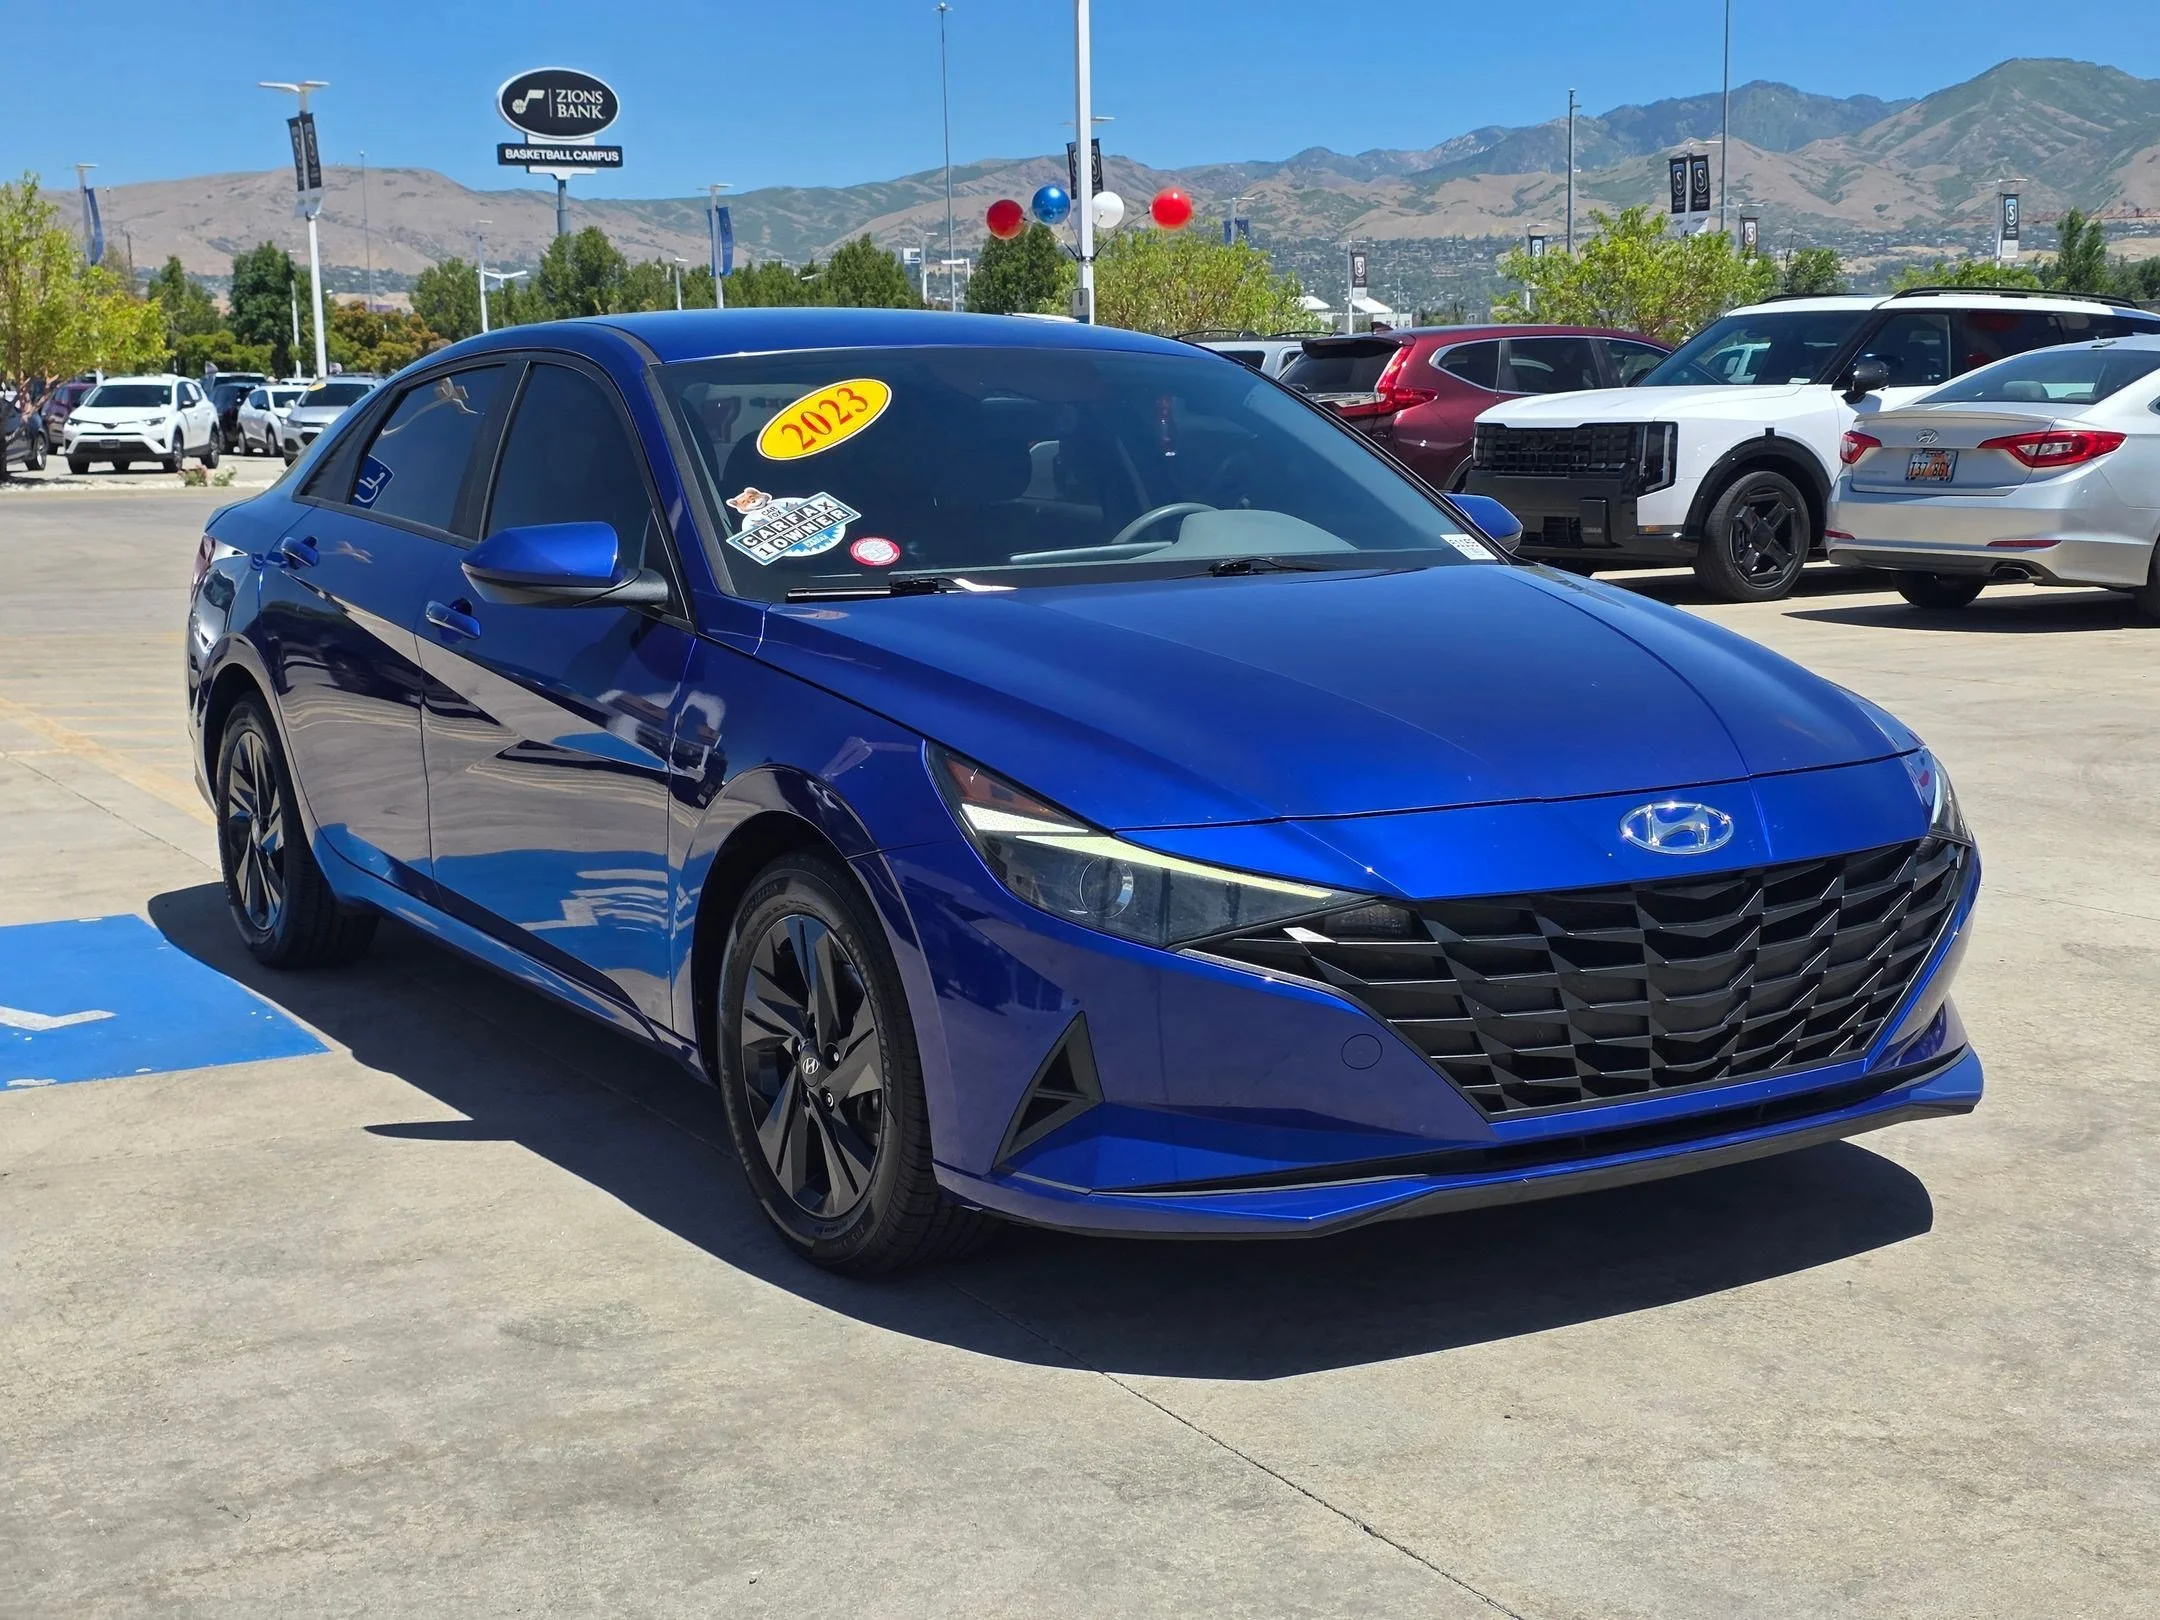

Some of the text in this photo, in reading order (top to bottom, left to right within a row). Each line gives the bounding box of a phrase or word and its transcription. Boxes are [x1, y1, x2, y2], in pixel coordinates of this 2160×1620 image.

[556, 89, 603, 104] ZIONS
[557, 104, 603, 119] BANK
[505, 148, 619, 161] BASKETBALL CAMPUS
[781, 387, 868, 450] 2023
[761, 506, 778, 516] CAR
[768, 510, 782, 520] FOX
[742, 501, 834, 547] CARFAX
